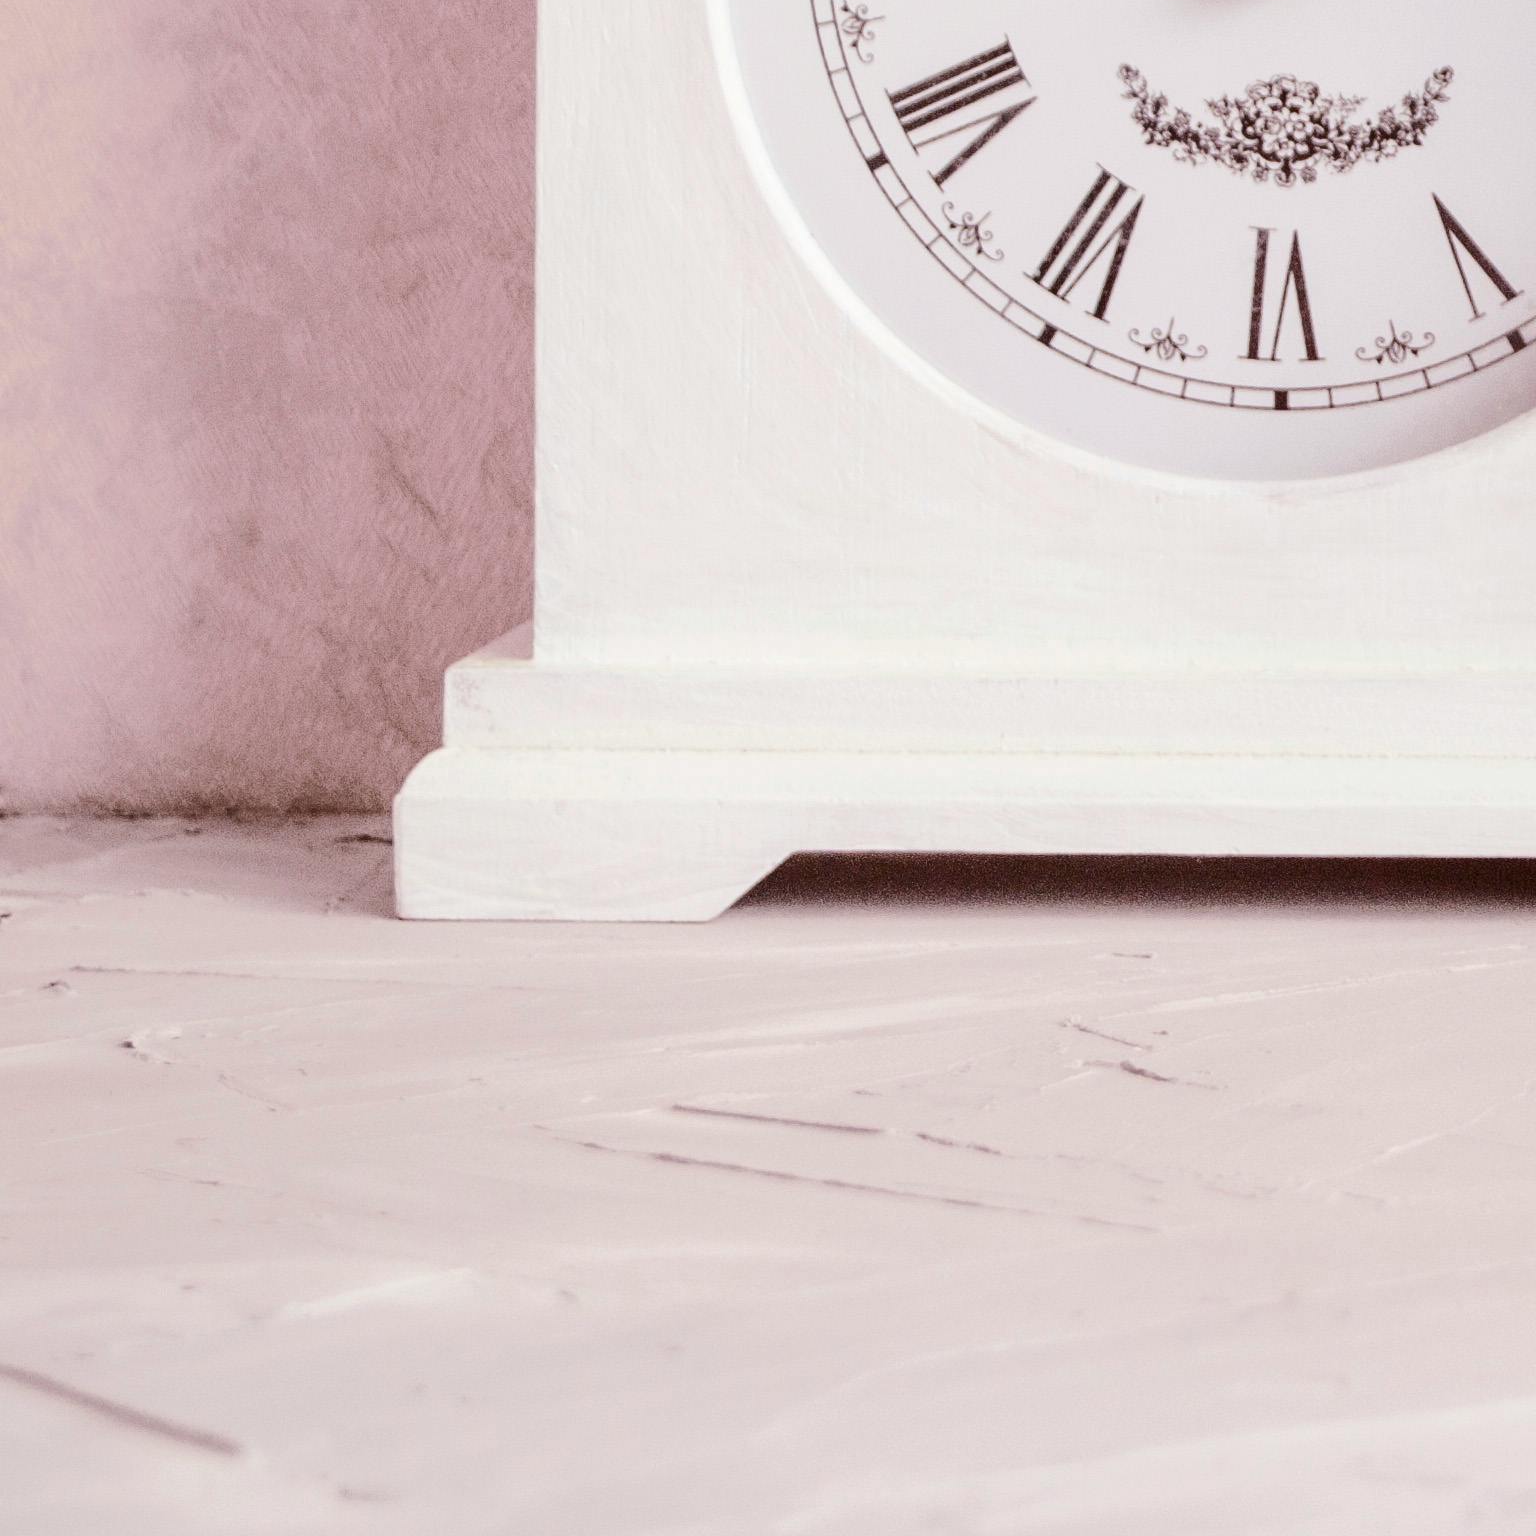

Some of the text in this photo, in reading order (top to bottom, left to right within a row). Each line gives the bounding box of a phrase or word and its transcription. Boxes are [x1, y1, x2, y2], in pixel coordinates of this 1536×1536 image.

[885, 34, 1038, 193] VIII
[1023, 163, 1146, 324] VII
[1238, 226, 1326, 363] VI
[1432, 192, 1525, 322] V
